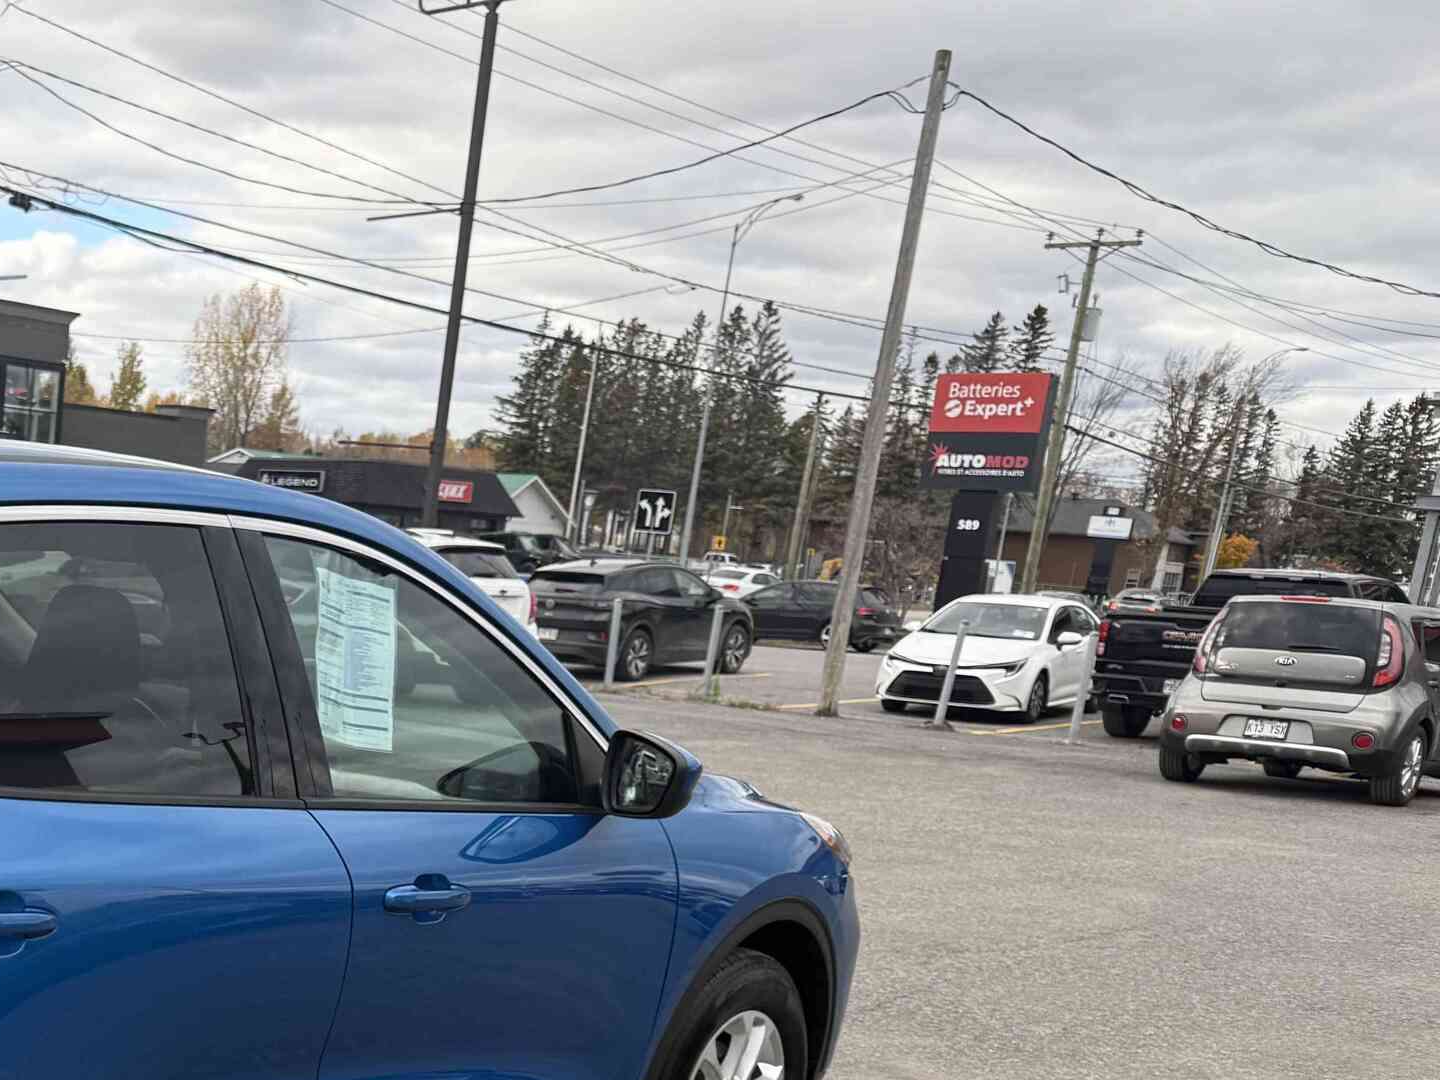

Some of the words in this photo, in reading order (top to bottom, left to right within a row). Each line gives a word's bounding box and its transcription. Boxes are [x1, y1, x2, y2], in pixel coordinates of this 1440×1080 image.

[949, 382, 1021, 399] Batteries
[935, 453, 1030, 469] AUTOMOD
[271, 475, 319, 487] LEGEND
